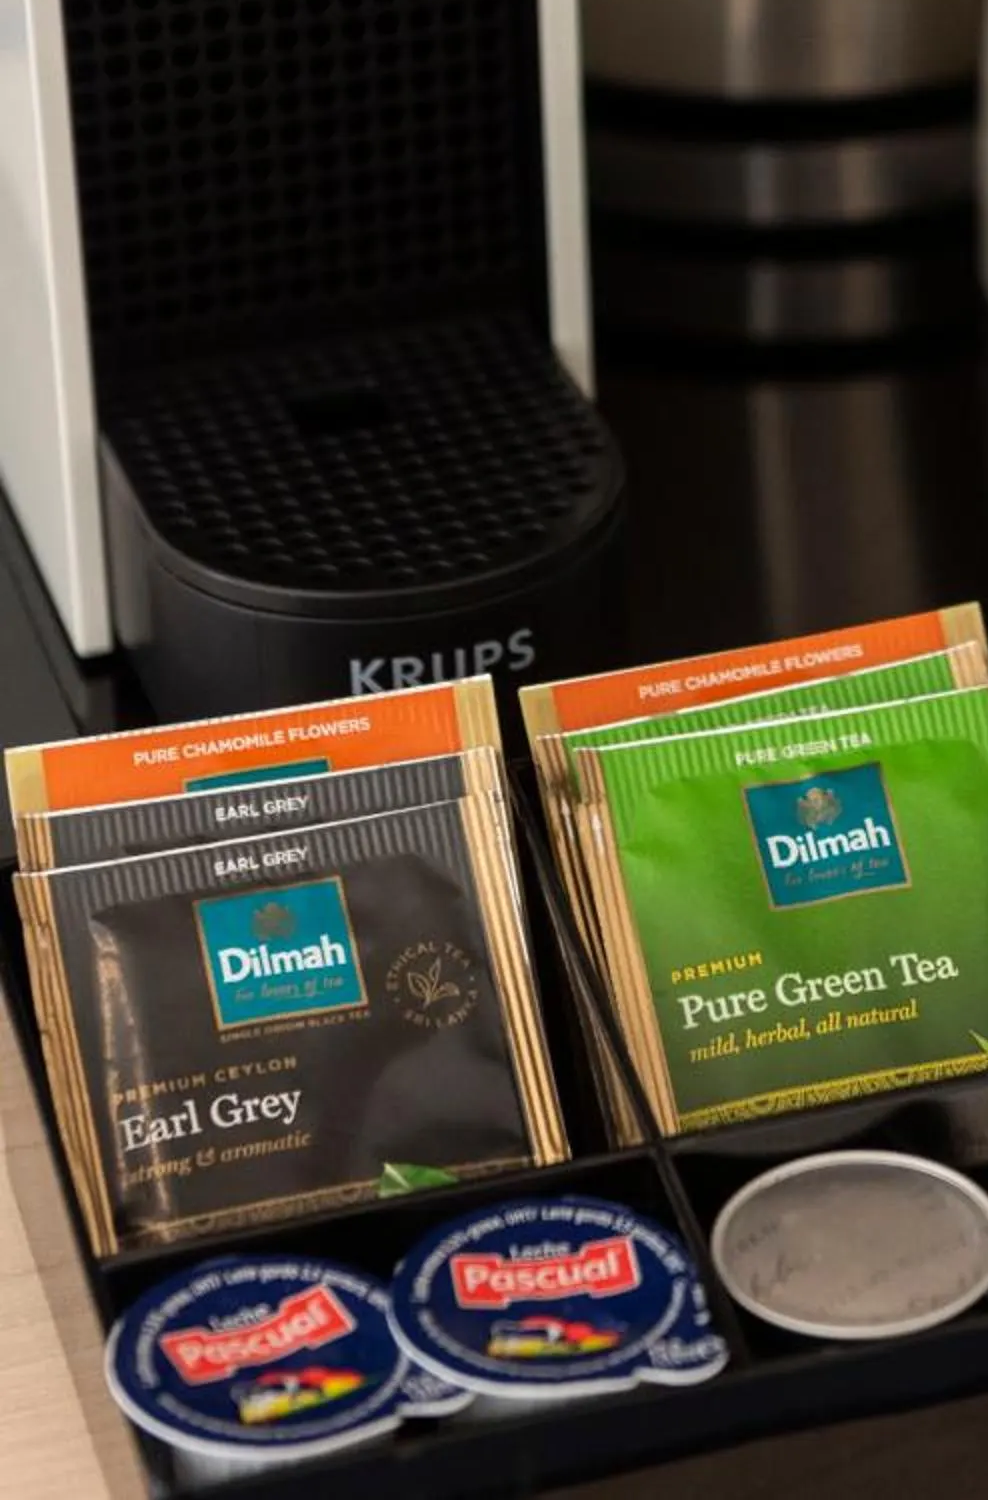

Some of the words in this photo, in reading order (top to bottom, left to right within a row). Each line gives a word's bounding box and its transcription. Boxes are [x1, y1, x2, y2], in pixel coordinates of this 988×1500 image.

[350, 628, 536, 696] KRUPS
[638, 678, 684, 700] PURE
[685, 659, 782, 690] CHAMOMILE
[784, 643, 864, 671] FLOWERS
[132, 746, 180, 767] PURE
[182, 730, 287, 758] CHAMOMILE
[288, 717, 371, 741] FLOWERS
[735, 746, 777, 767] PURE
[782, 738, 838, 760] GREEN
[839, 731, 873, 750] TEA
[215, 804, 260, 822] EARL
[263, 795, 310, 815] GREY
[214, 857, 260, 876] EARL
[262, 847, 309, 868] GREY
[766, 817, 892, 869] Dilmah
[217, 933, 348, 984] Dilmah
[671, 952, 763, 985] PREMIUM
[678, 988, 769, 1030] Pure
[775, 967, 888, 1007] Green
[889, 953, 960, 987] Tea
[690, 1032, 741, 1064] mild,
[745, 1018, 811, 1049] herbal,
[816, 1011, 842, 1035] all
[847, 999, 919, 1029] natural
[112, 1073, 206, 1104] PREMIUM
[214, 1056, 298, 1082] CEYLON
[120, 1100, 203, 1151] Earl
[210, 1089, 302, 1128] Grey
[220, 1130, 313, 1162] aromatic
[462, 1252, 623, 1293] Pascual
[178, 1302, 330, 1365] Pascual
